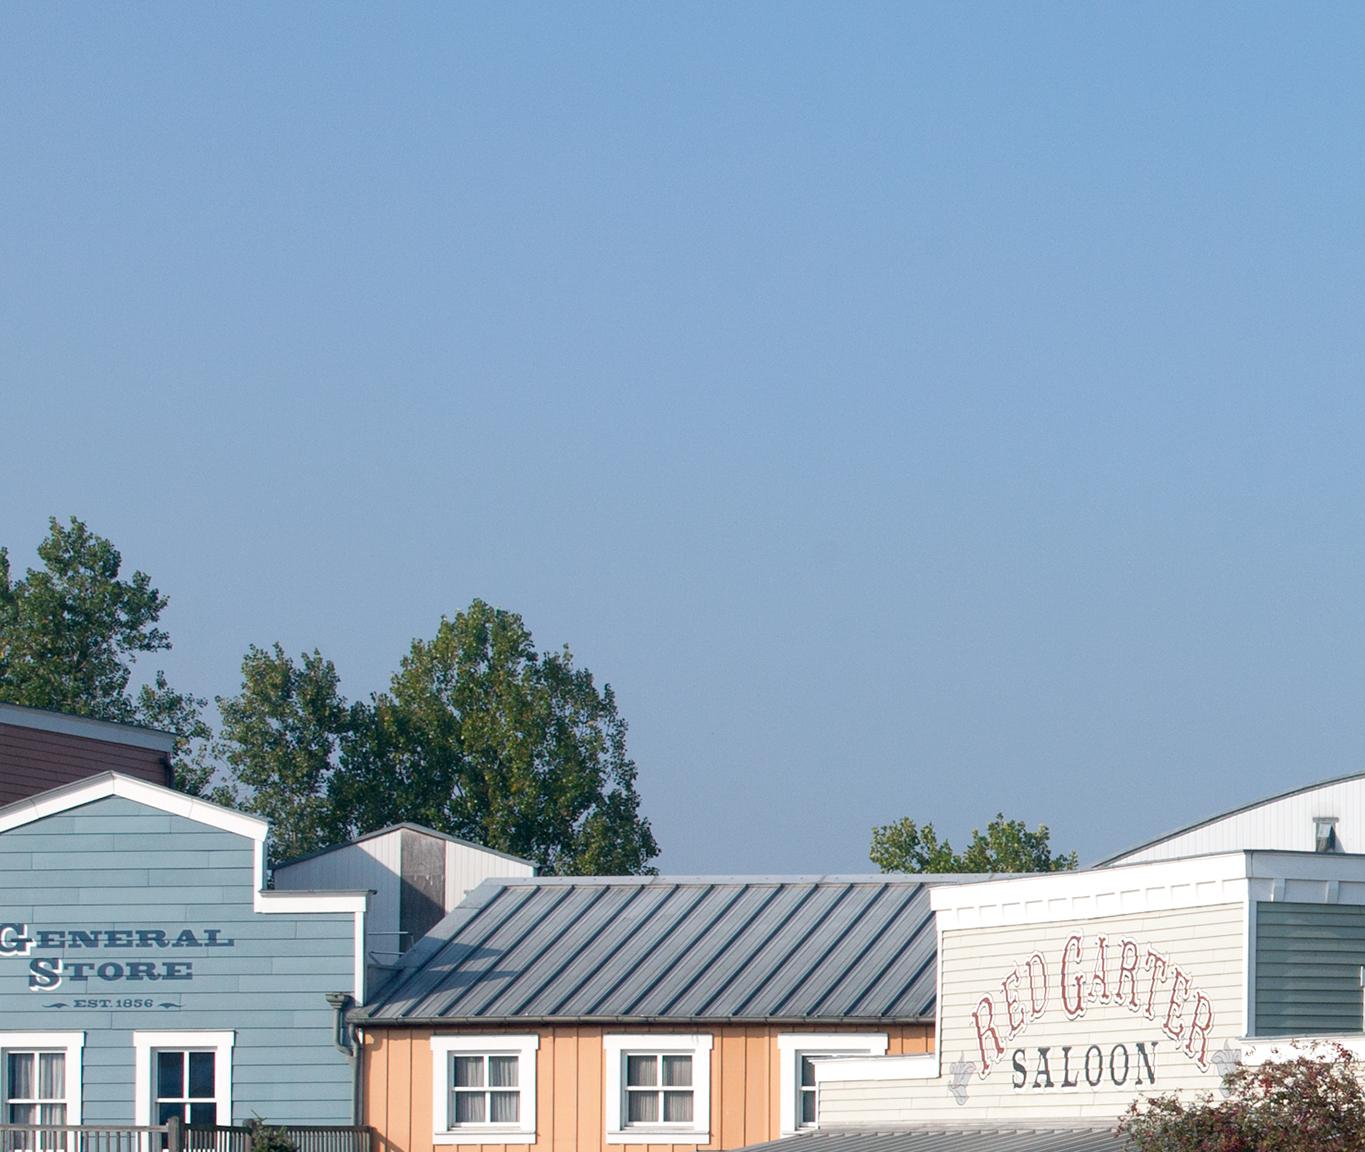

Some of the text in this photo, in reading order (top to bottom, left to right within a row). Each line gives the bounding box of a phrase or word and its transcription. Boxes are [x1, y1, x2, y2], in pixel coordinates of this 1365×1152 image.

[0, 923, 235, 956] GENERAL
[28, 957, 193, 991] STORE
[116, 998, 154, 1008] 1856
[971, 928, 1215, 1079] RED GARTER
[1012, 1041, 1159, 1089] SALOON
